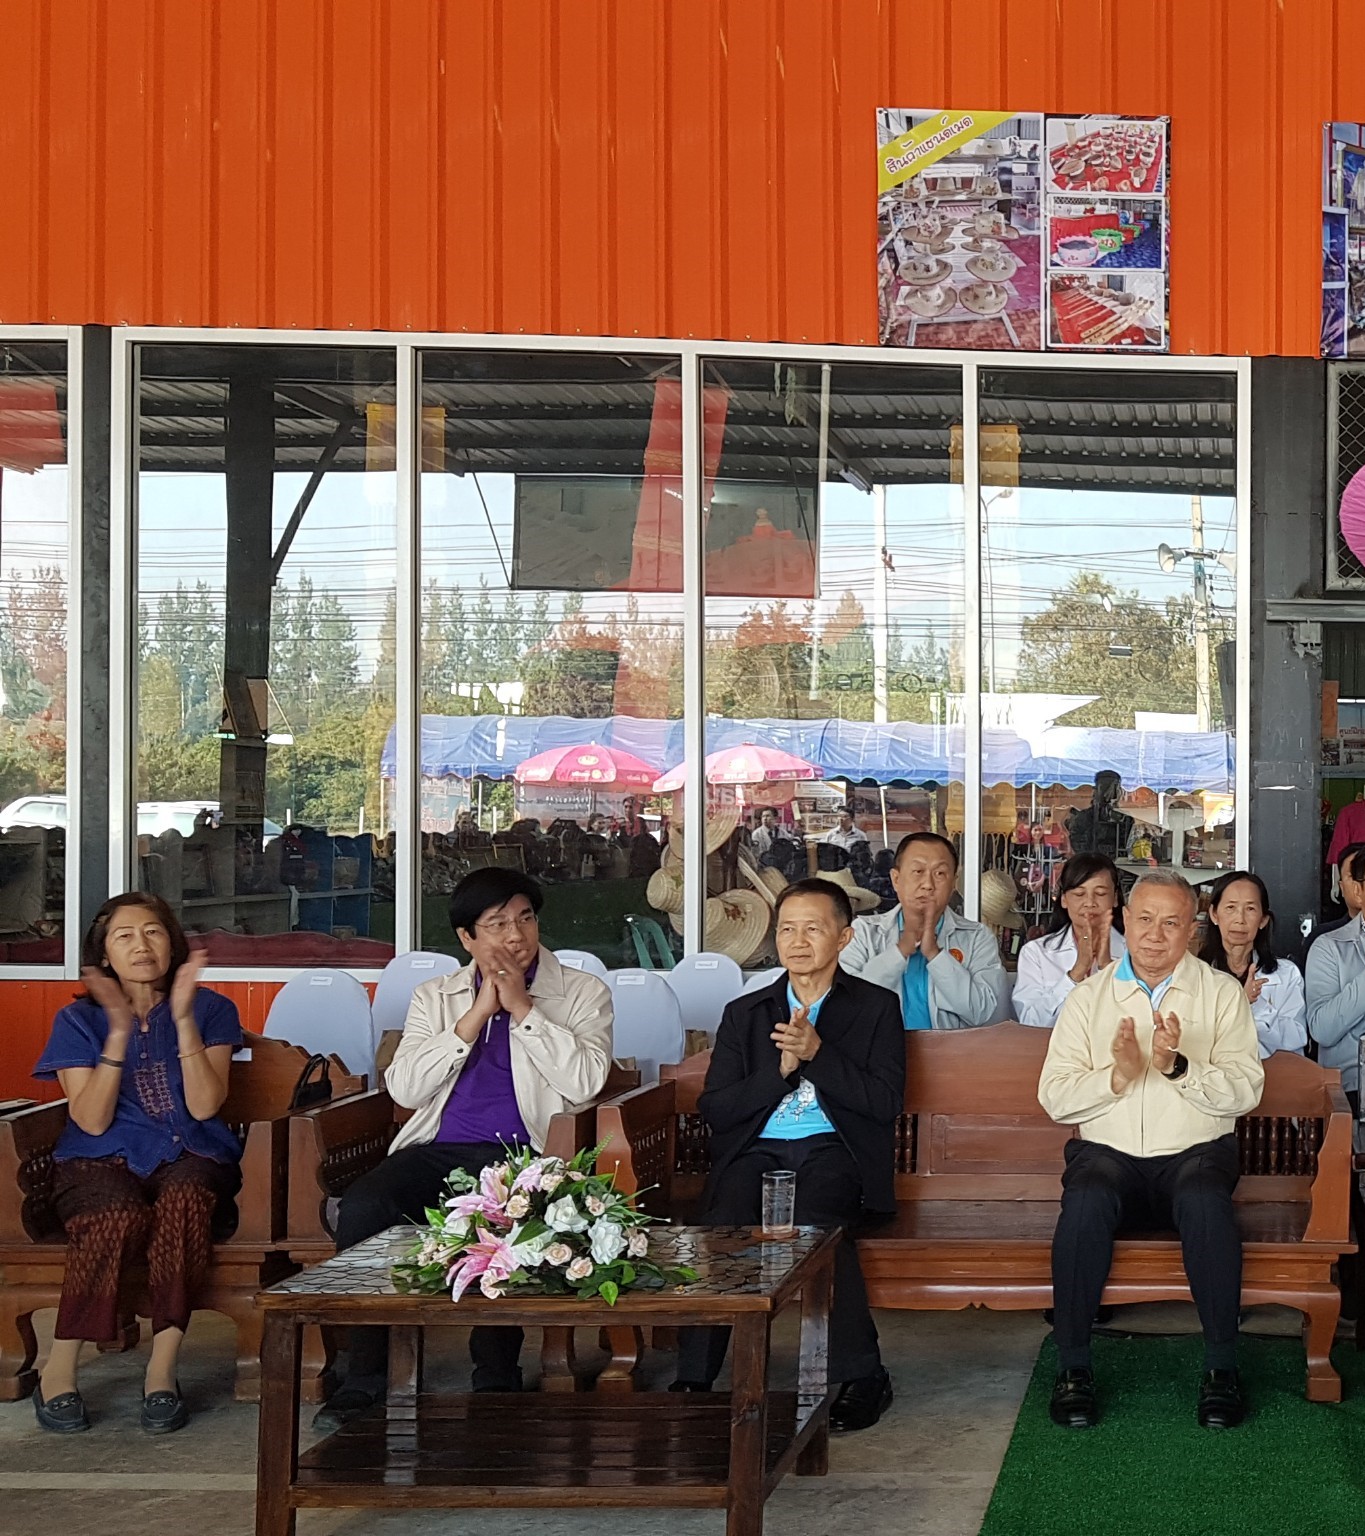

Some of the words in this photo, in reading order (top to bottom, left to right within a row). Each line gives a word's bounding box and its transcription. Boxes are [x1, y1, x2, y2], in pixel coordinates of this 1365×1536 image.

[885, 115, 974, 175] สินค้าแฮนด์เมด
